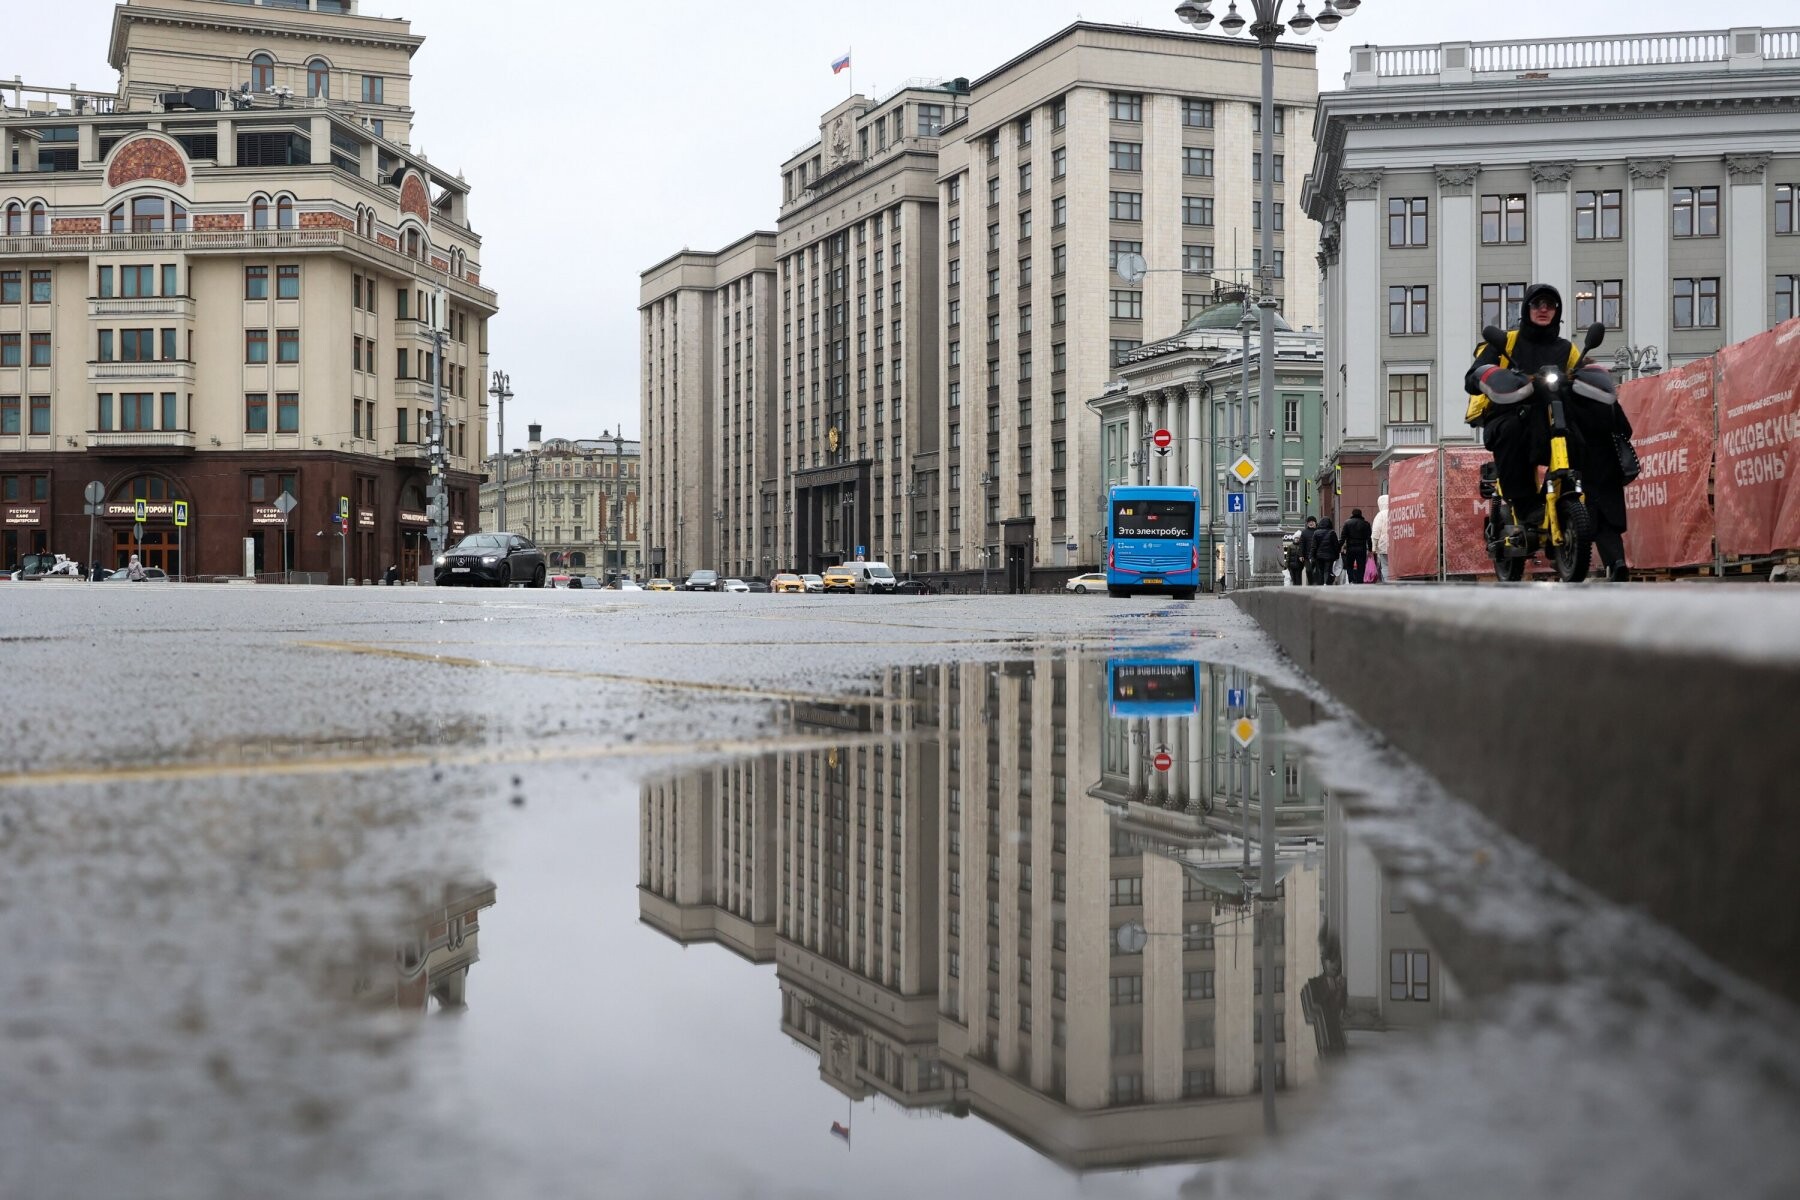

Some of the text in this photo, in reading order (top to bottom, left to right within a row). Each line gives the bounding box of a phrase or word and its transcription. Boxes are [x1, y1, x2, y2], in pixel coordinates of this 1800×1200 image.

[1636, 448, 1688, 480] ОВСКИЕ
[1623, 480, 1667, 510] СЕЗОНЫ
[109, 506, 135, 514] СТРАНА
[145, 505, 167, 513] ТОРОЙ
[1118, 527, 1188, 537] Это электробус.
